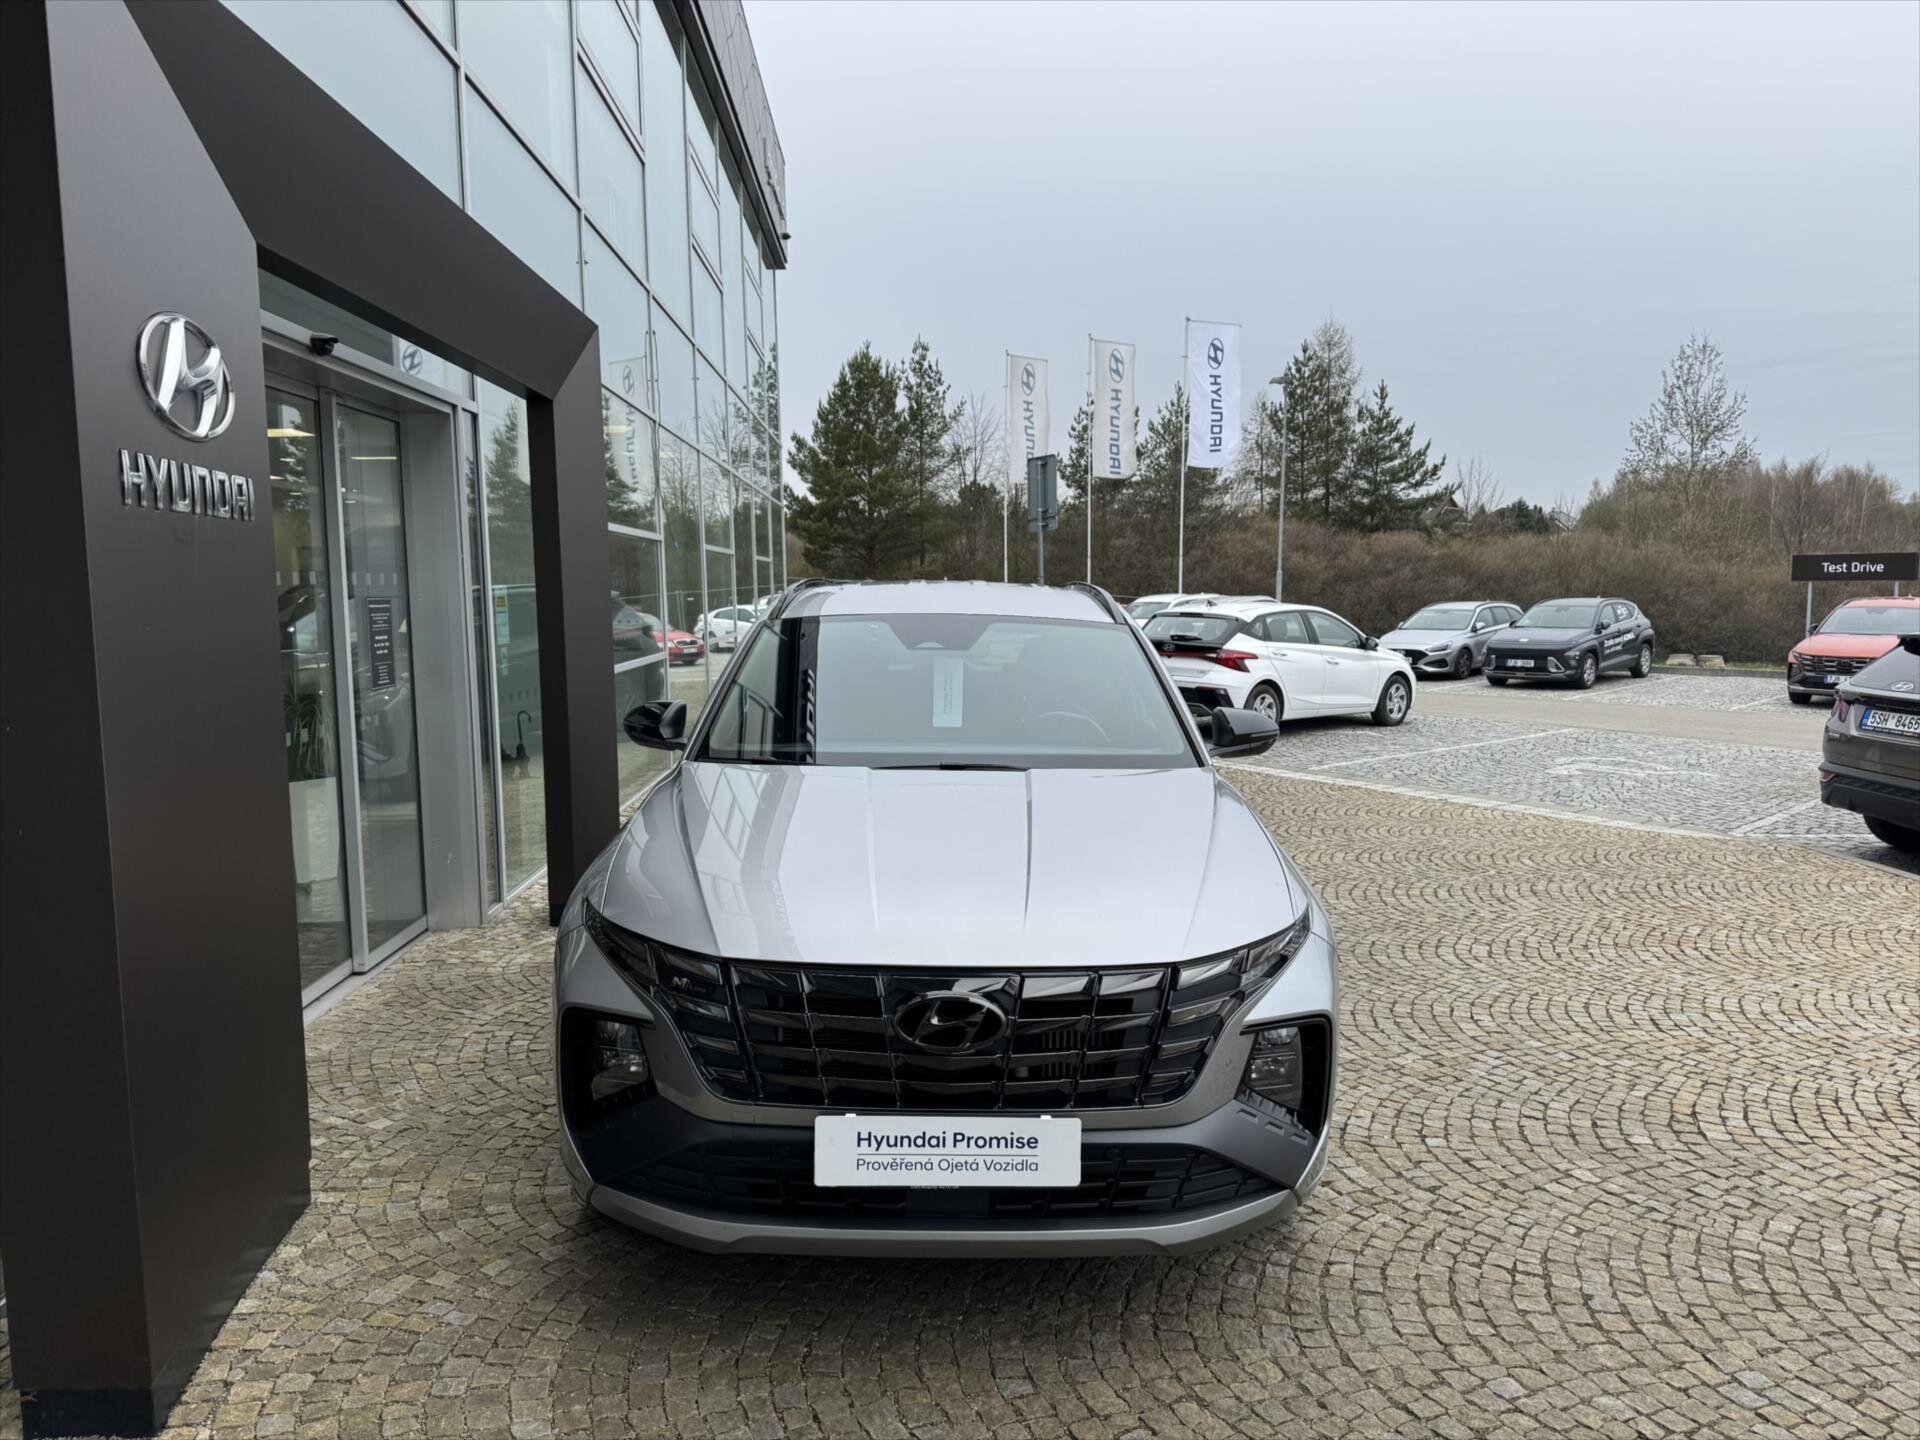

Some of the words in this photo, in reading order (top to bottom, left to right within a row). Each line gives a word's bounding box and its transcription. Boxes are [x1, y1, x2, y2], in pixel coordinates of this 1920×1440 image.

[1208, 375, 1223, 453] HYUNDAI
[1109, 389, 1122, 475] HYUNDAI
[120, 449, 255, 521] HYUNDAI
[1822, 562, 1847, 573] Test
[1851, 562, 1884, 573] Drive
[1871, 712, 1890, 726] 5SH
[1895, 715, 1920, 730] 8465
[856, 1130, 947, 1151] Hyundai
[953, 1131, 1039, 1150] Promise
[856, 1156, 934, 1172] Prověřená
[938, 1156, 979, 1174] Ojetá
[983, 1157, 1039, 1172] Vozidla
